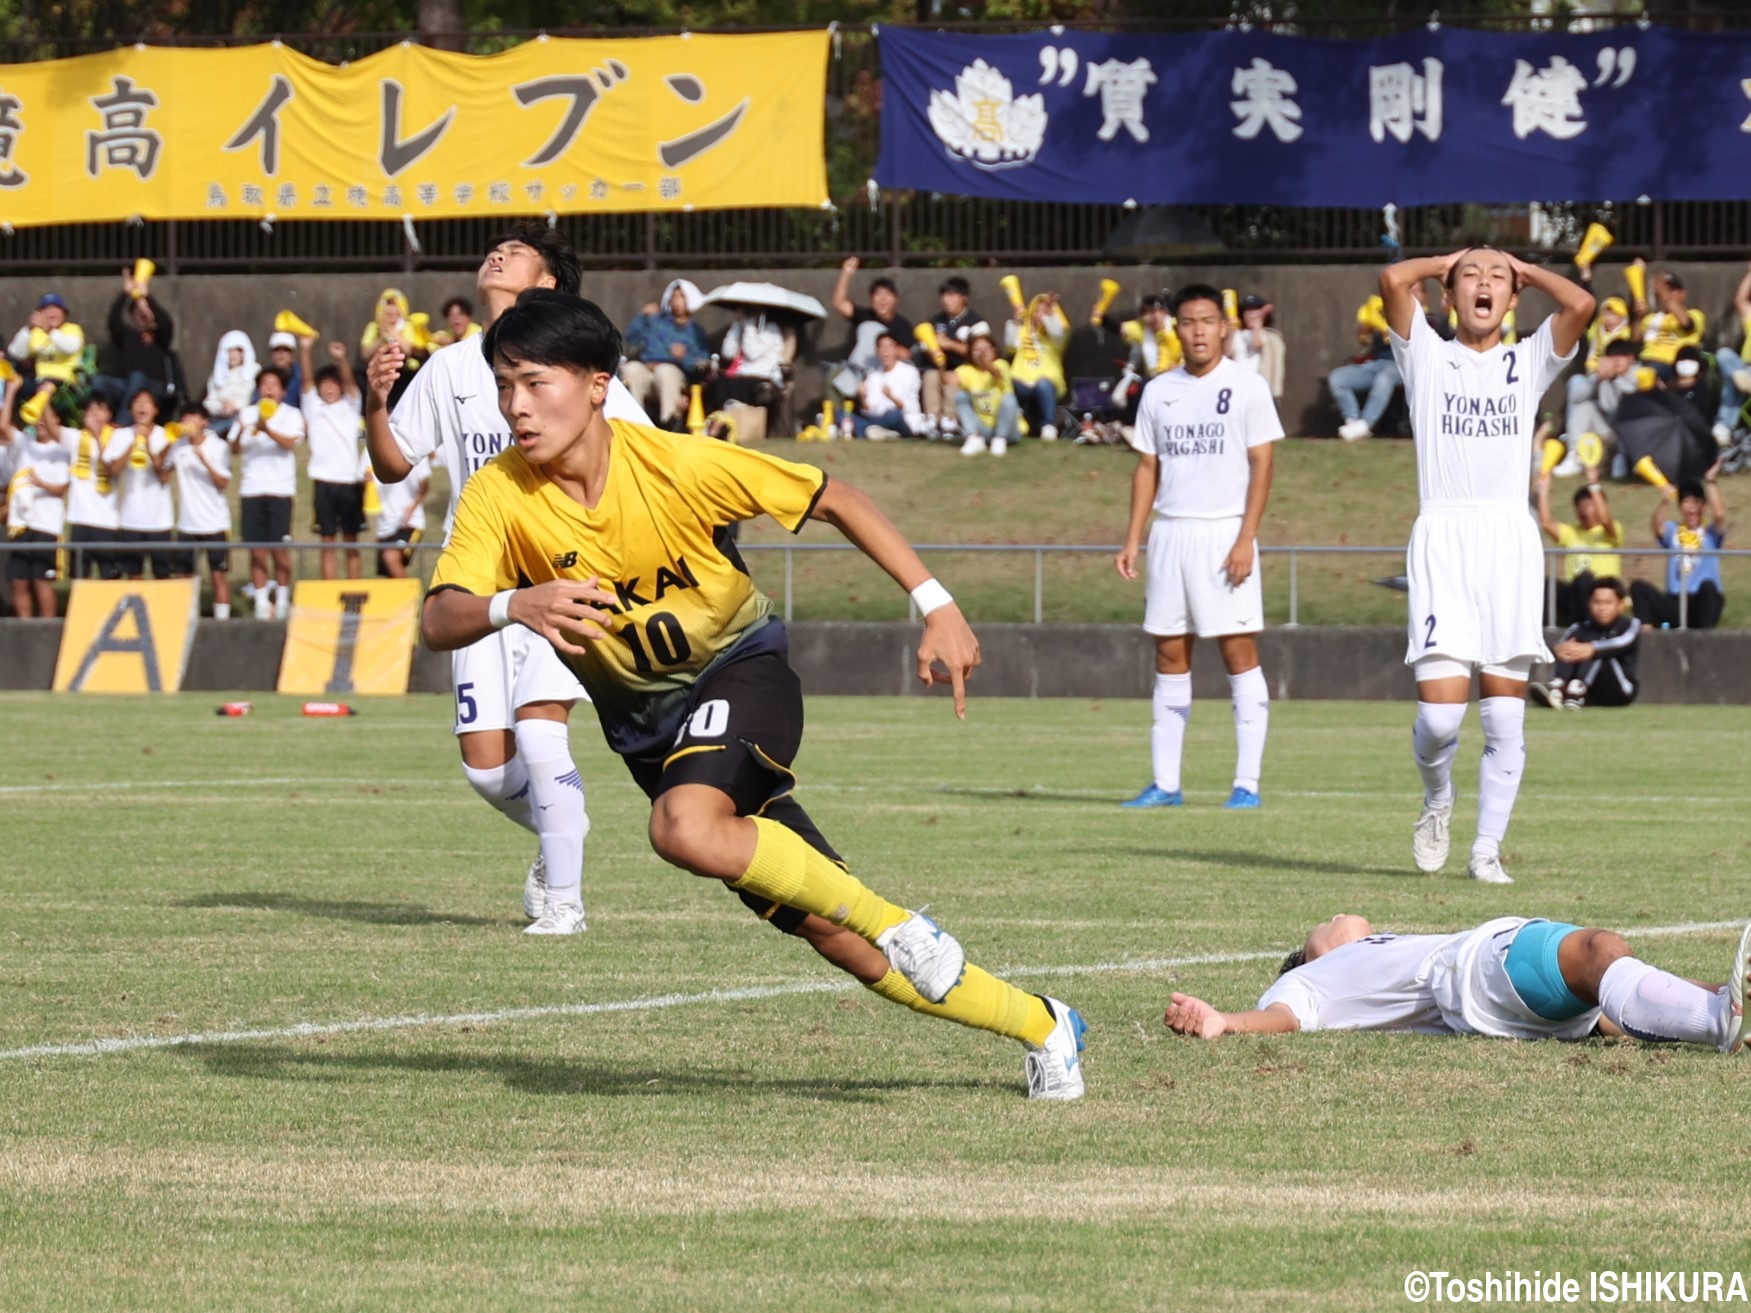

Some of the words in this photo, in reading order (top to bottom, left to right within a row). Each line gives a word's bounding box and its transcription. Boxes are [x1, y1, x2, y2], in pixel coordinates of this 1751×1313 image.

[1502, 350, 1519, 384] 2
[1216, 388, 1232, 414] 8
[1443, 393, 1516, 417] YONAGO
[1164, 422, 1224, 440] YONAGO
[1442, 414, 1518, 437] HIGASHI
[572, 555, 700, 620] AKAI
[68, 593, 163, 692] A
[324, 592, 370, 693] I
[616, 611, 692, 672] 10
[1423, 613, 1437, 649] 2
[457, 682, 478, 724] 5
